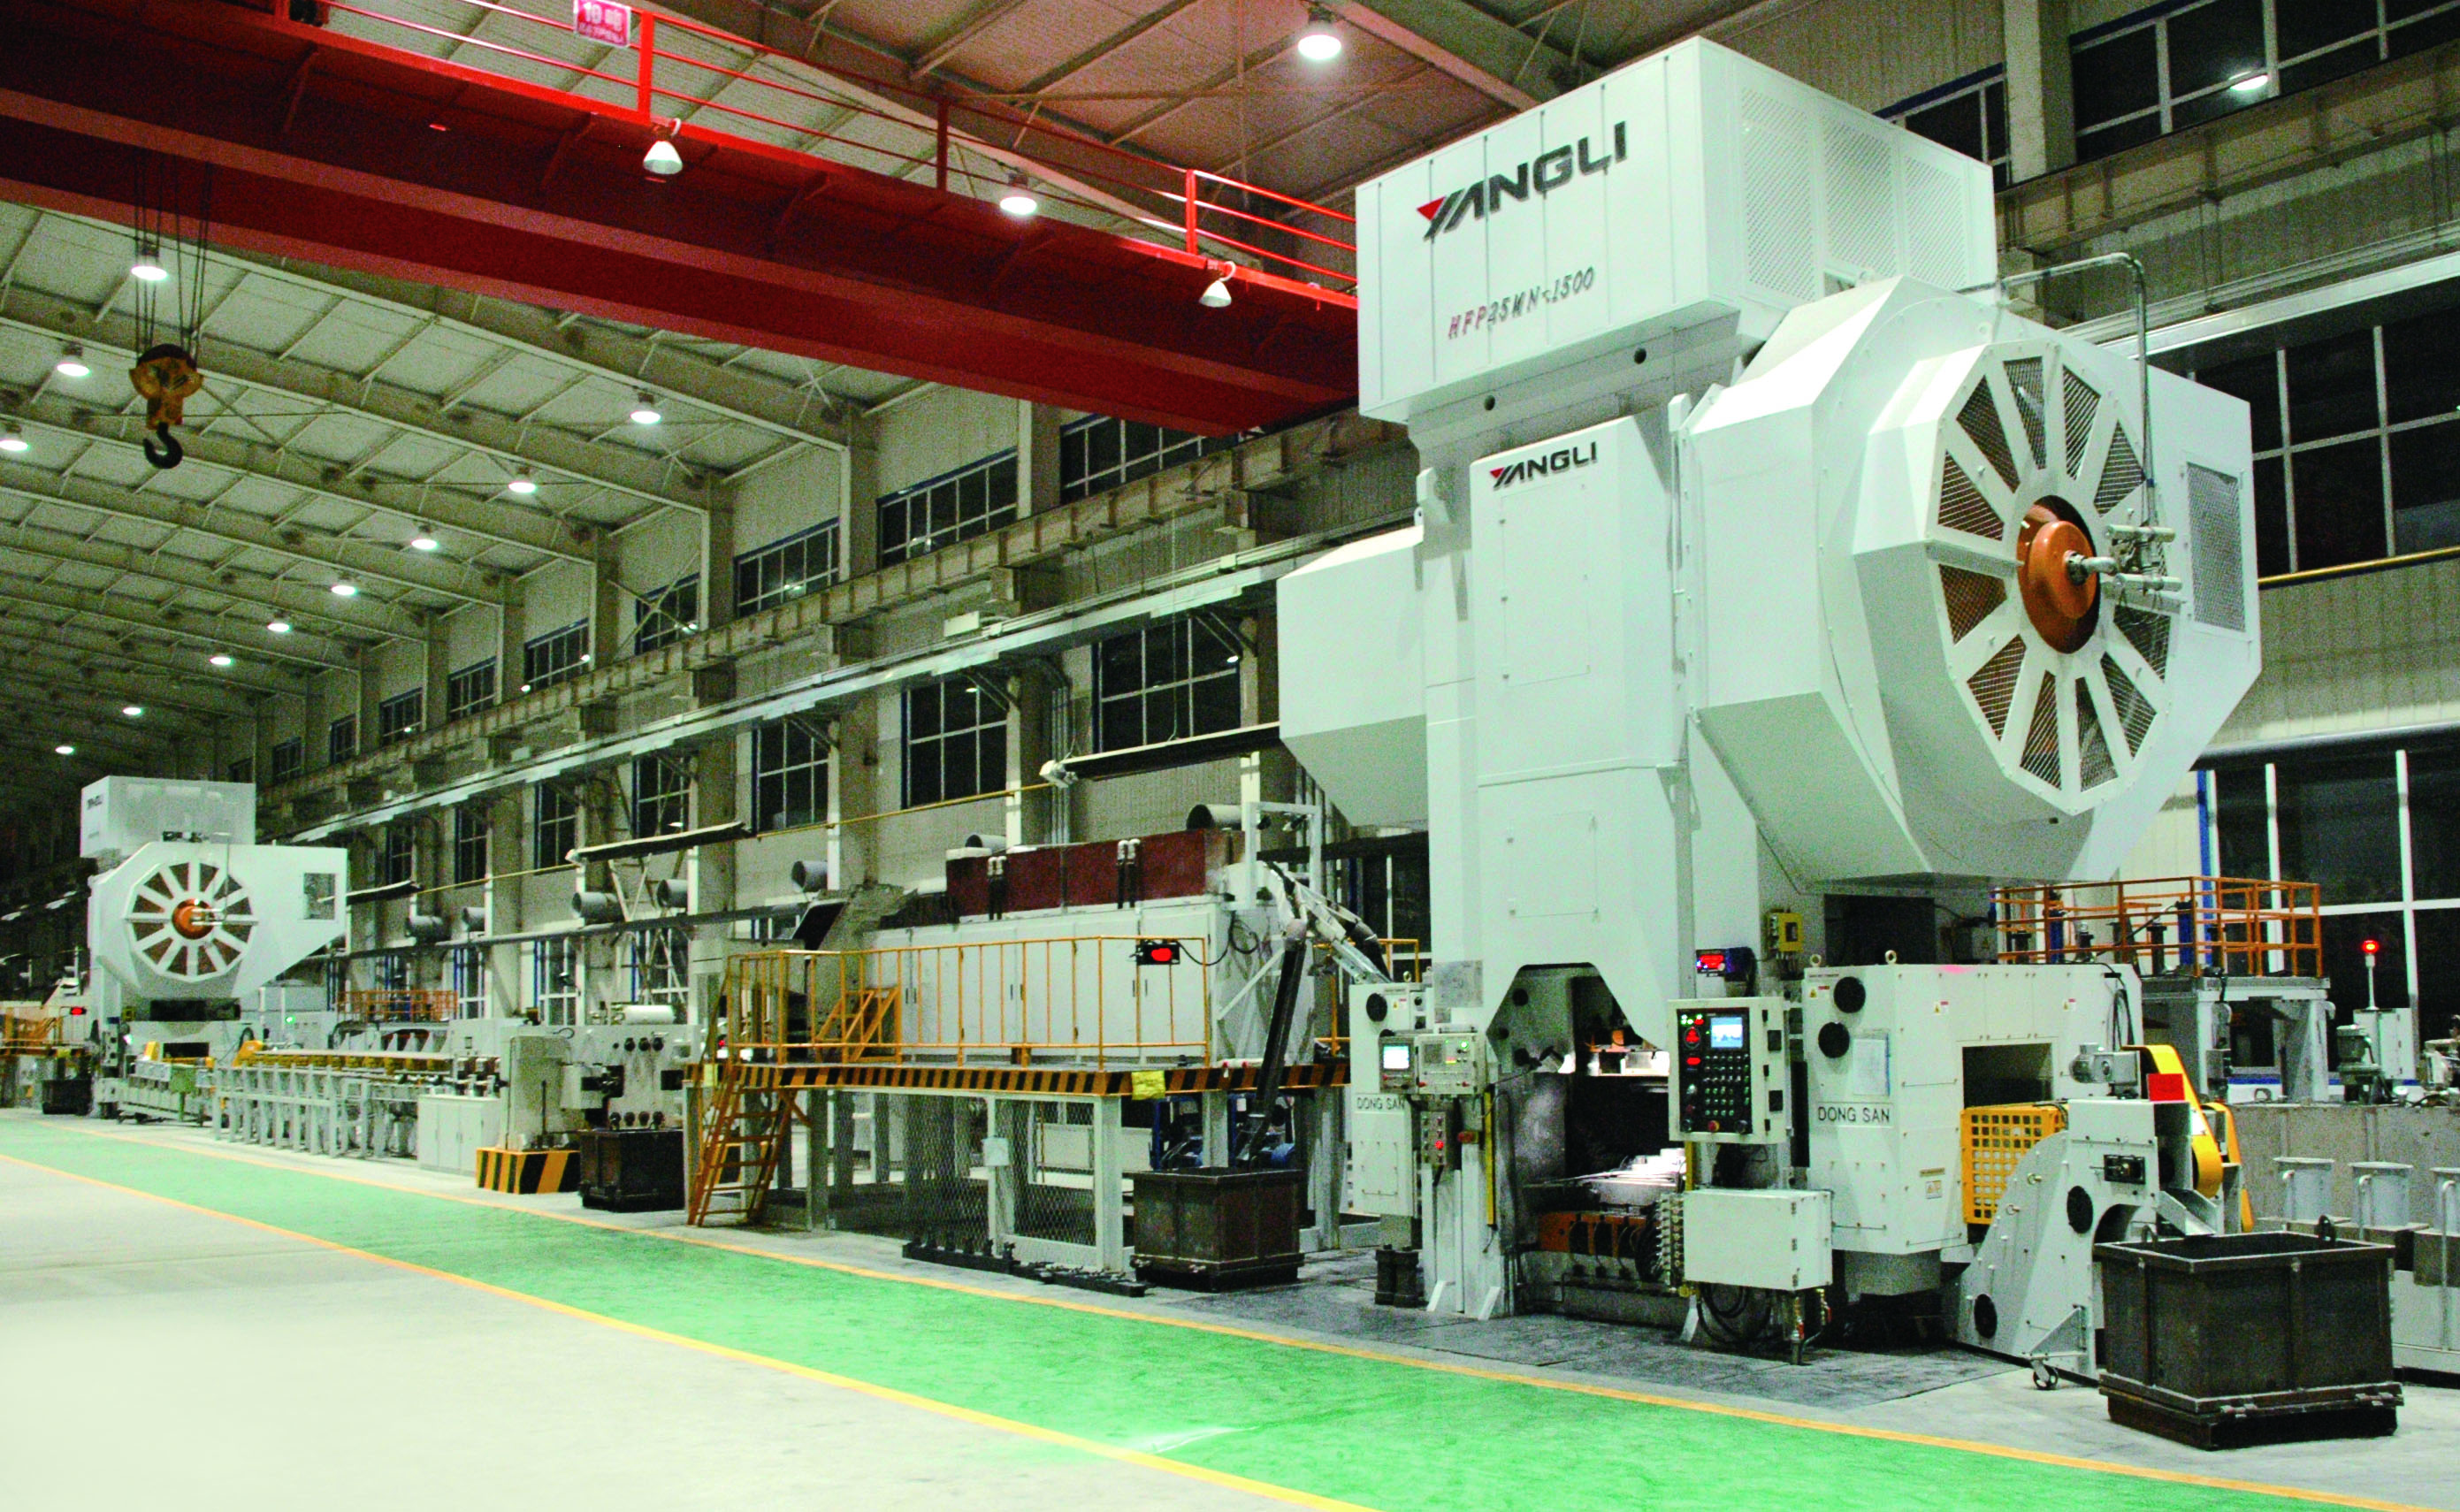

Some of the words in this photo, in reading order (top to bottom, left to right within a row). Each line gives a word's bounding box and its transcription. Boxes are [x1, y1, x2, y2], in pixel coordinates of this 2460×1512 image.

[1417, 120, 1627, 241] YANGLI
[1489, 440, 1597, 489] YANGLI
[1356, 1096, 1383, 1110] DONG
[1817, 1106, 1857, 1122] DONG
[1861, 1107, 1891, 1123] SAN
